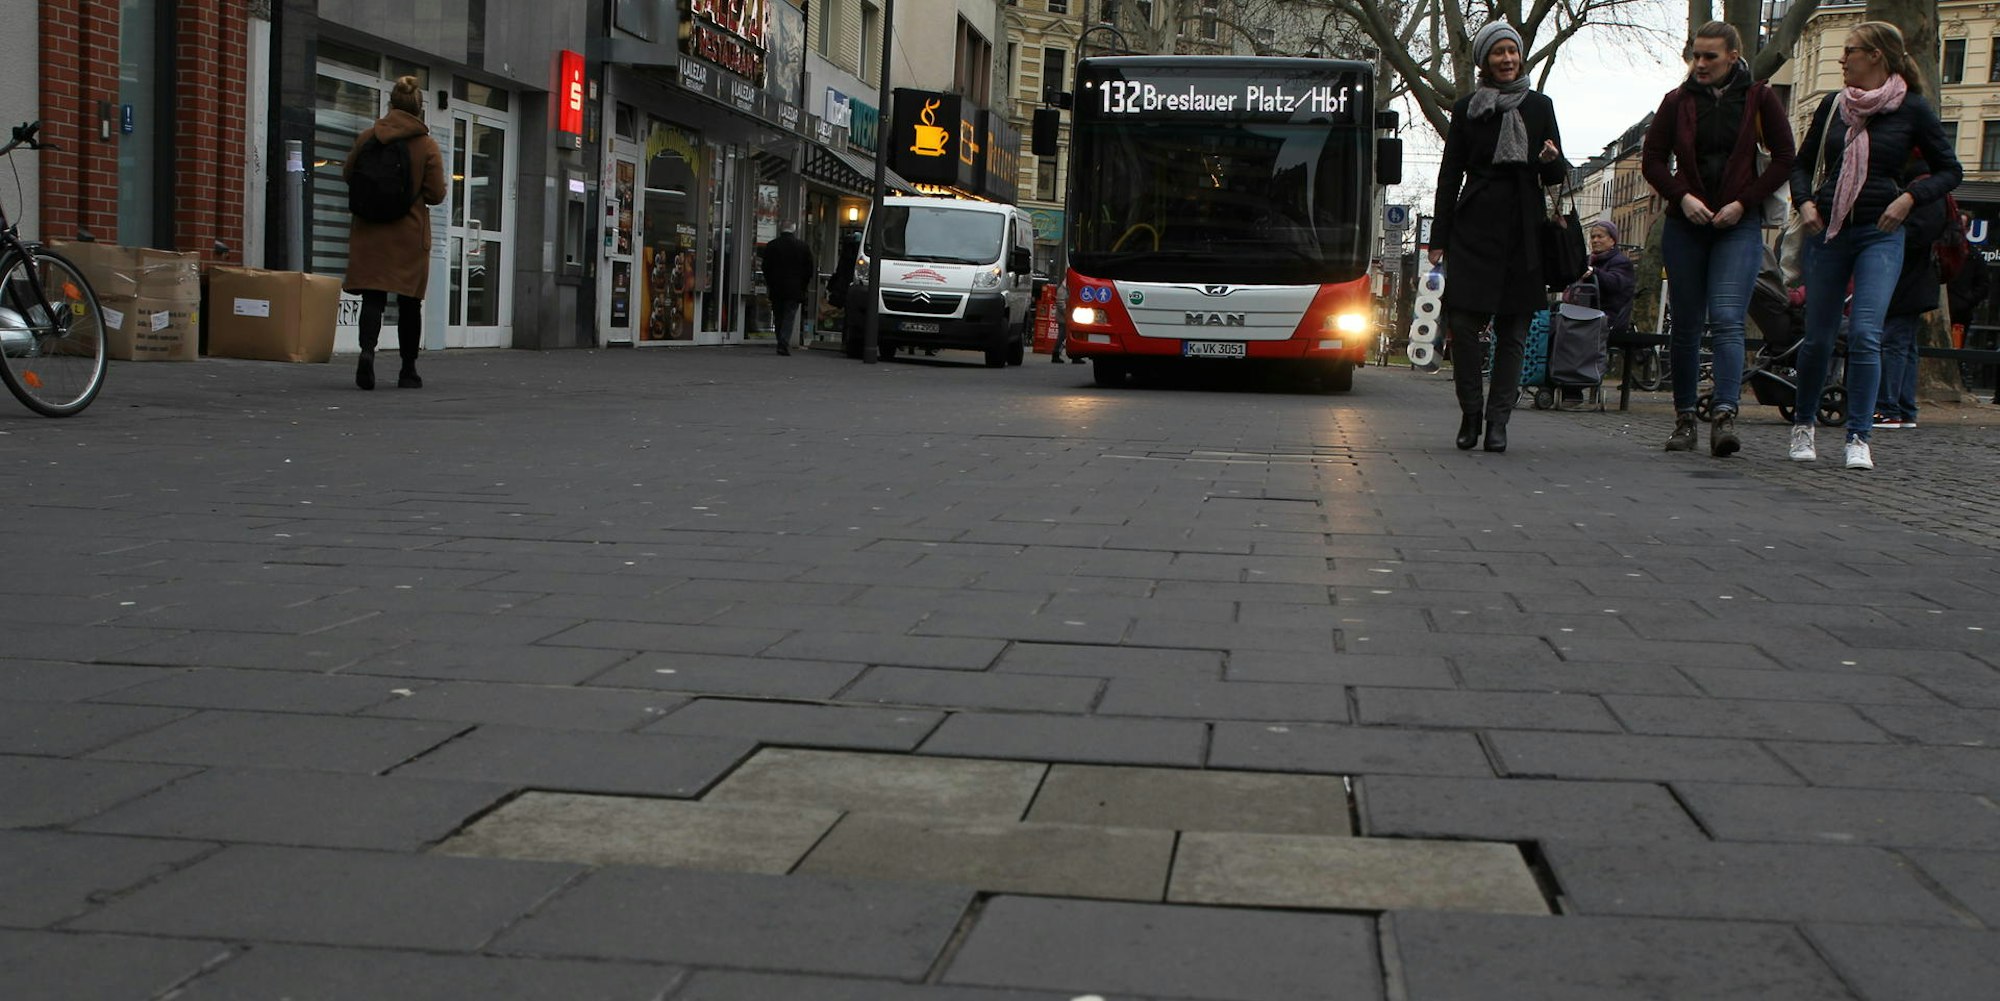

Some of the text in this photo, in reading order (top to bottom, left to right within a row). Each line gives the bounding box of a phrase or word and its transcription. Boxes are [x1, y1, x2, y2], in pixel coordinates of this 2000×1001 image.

[683, 58, 707, 84] LALEZAR
[734, 80, 755, 104] LALEZAR
[1099, 80, 1348, 114] 132 Breslauer Platz/Hbf
[1966, 219, 1988, 243] U
[1185, 311, 1245, 327] MAN
[1189, 343, 1244, 355] K VK 3051
